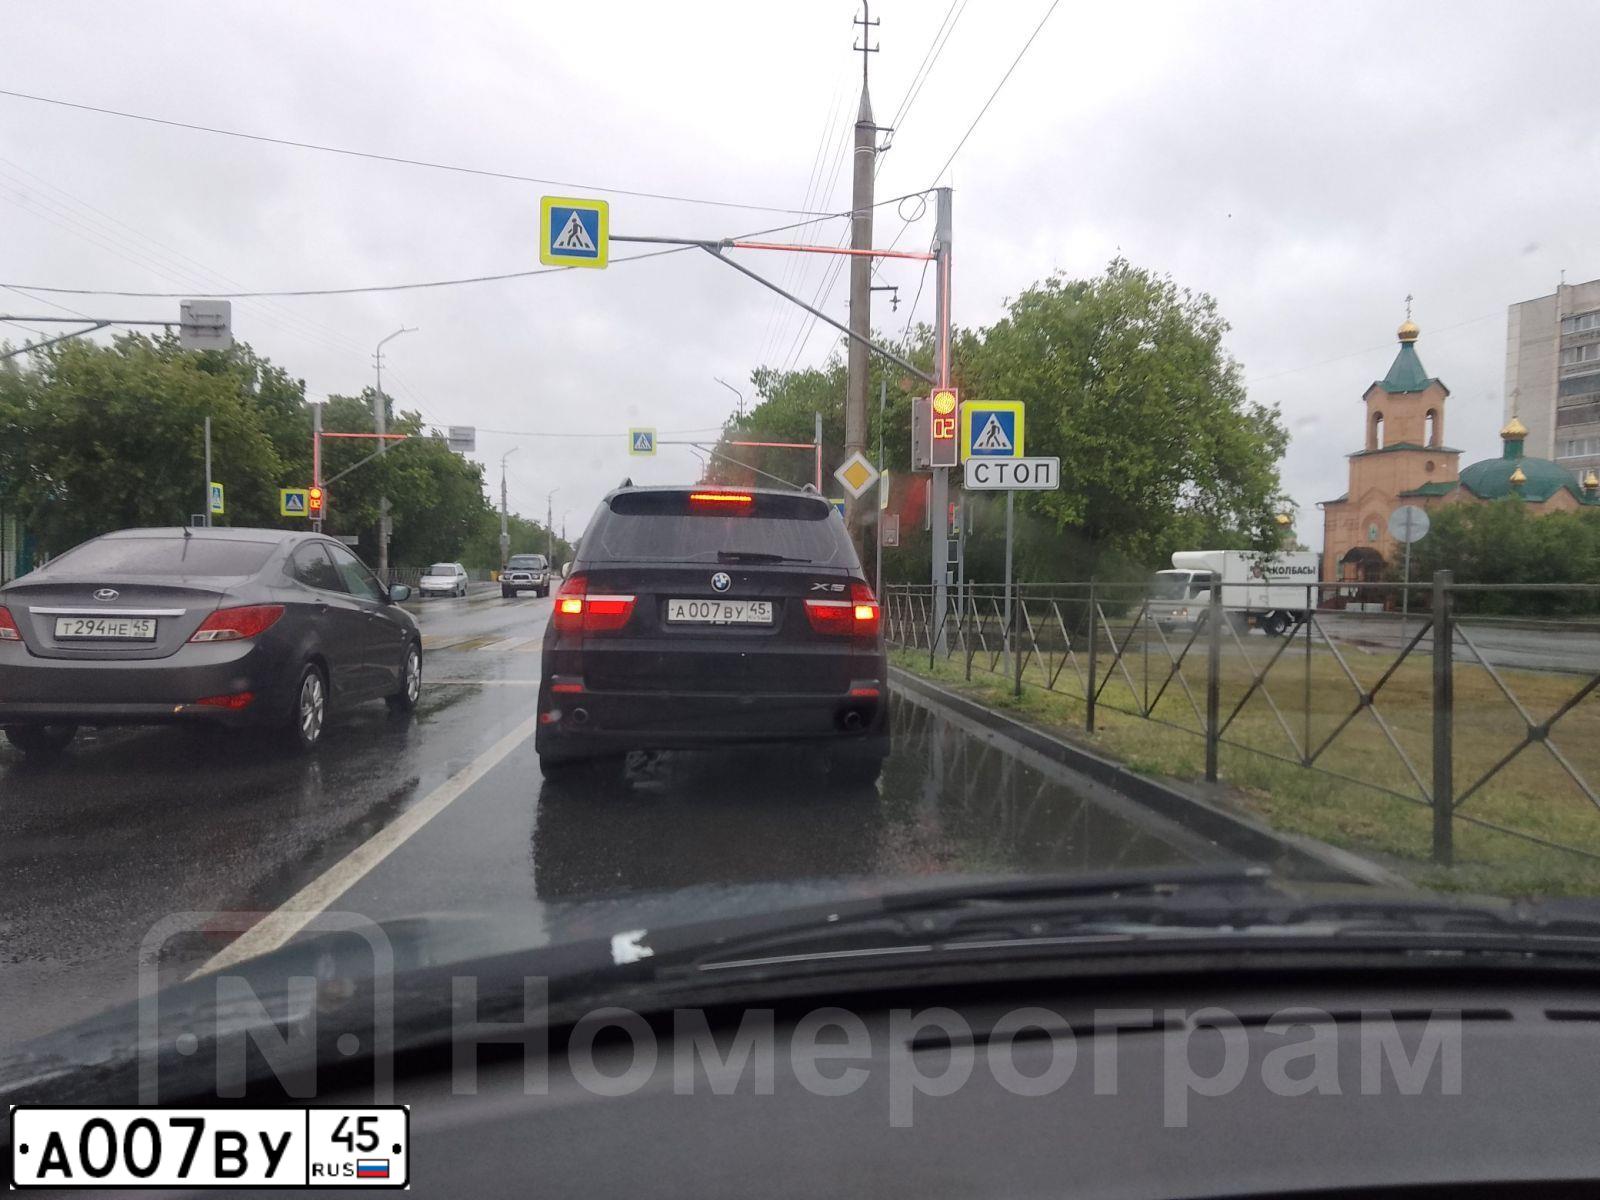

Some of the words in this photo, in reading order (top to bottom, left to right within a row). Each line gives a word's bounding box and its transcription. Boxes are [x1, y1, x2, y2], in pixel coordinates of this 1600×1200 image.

[933, 418, 955, 439] 02
[974, 463, 1050, 484] СТОП
[1272, 566, 1316, 575] КОЛБАСЫ
[810, 582, 846, 592] X5
[749, 602, 766, 615] 45
[133, 620, 149, 632] 45
